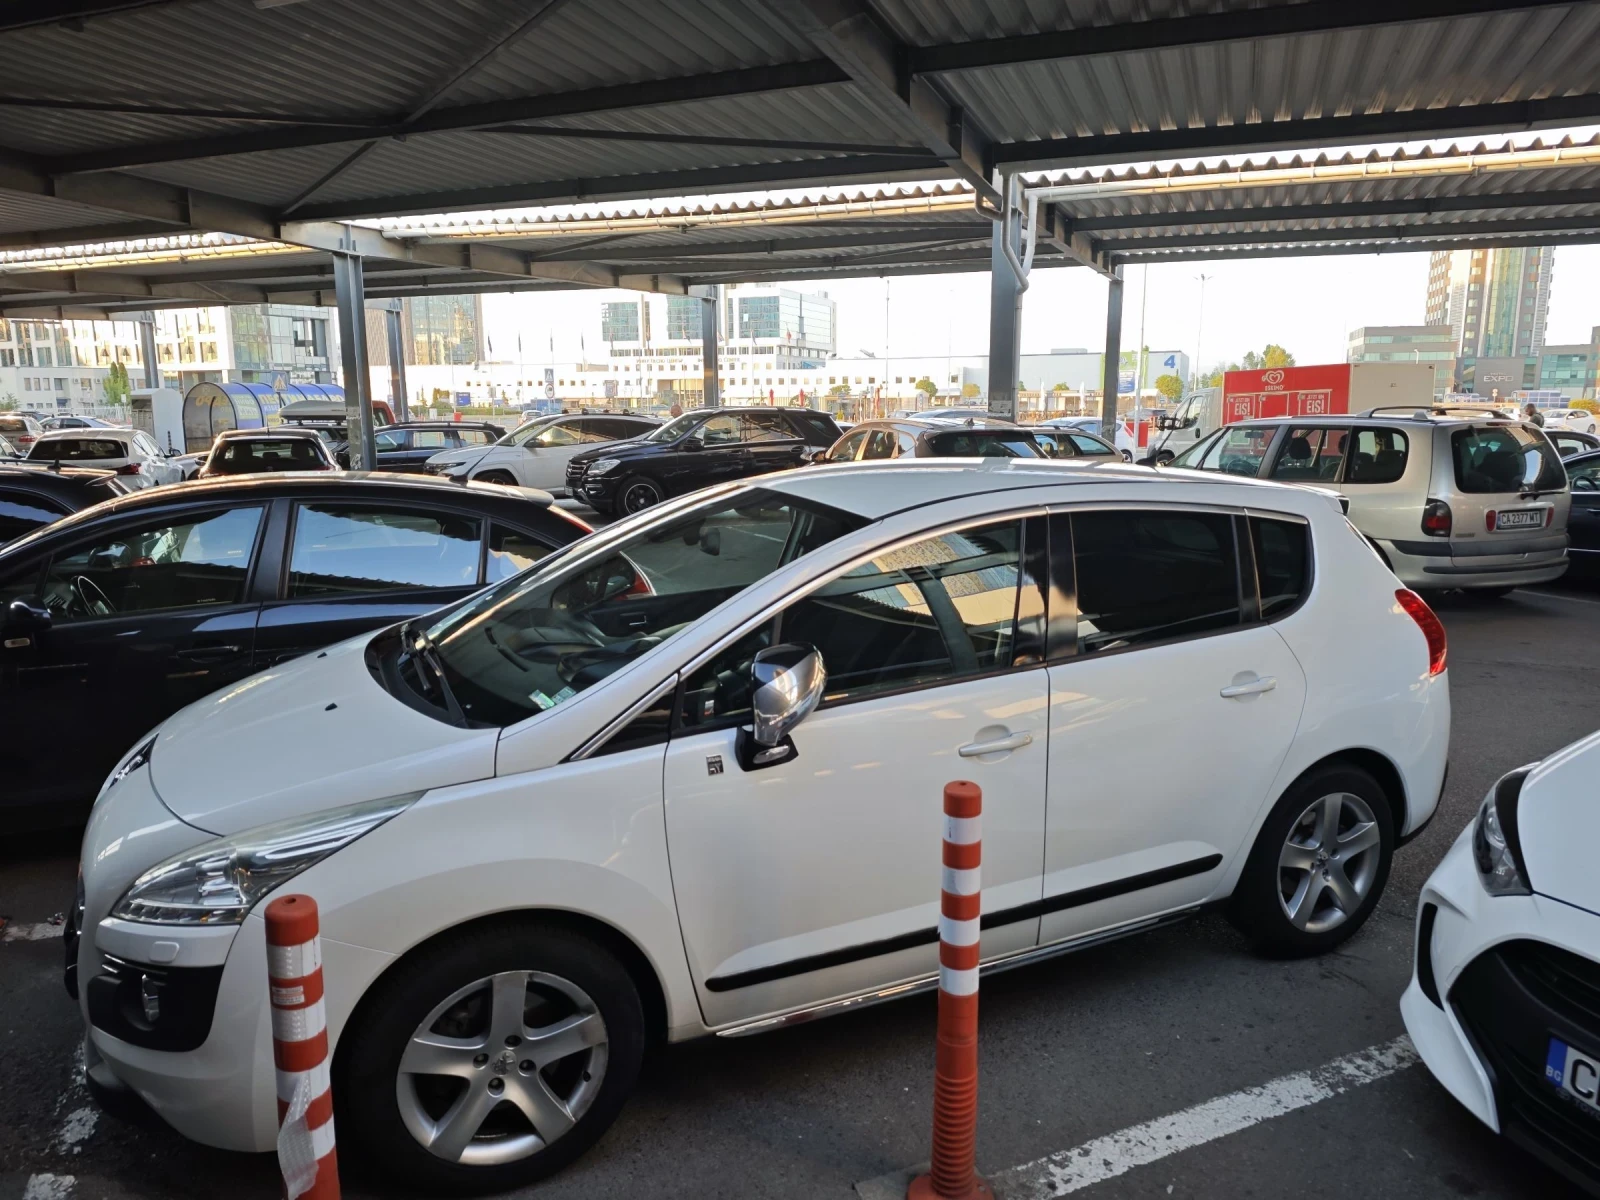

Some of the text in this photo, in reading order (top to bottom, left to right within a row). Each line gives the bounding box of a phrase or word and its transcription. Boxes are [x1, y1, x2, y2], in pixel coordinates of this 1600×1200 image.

[1164, 355, 1175, 368] 4
[1512, 513, 1528, 523] 2377
[1546, 1065, 1562, 1082] BG
